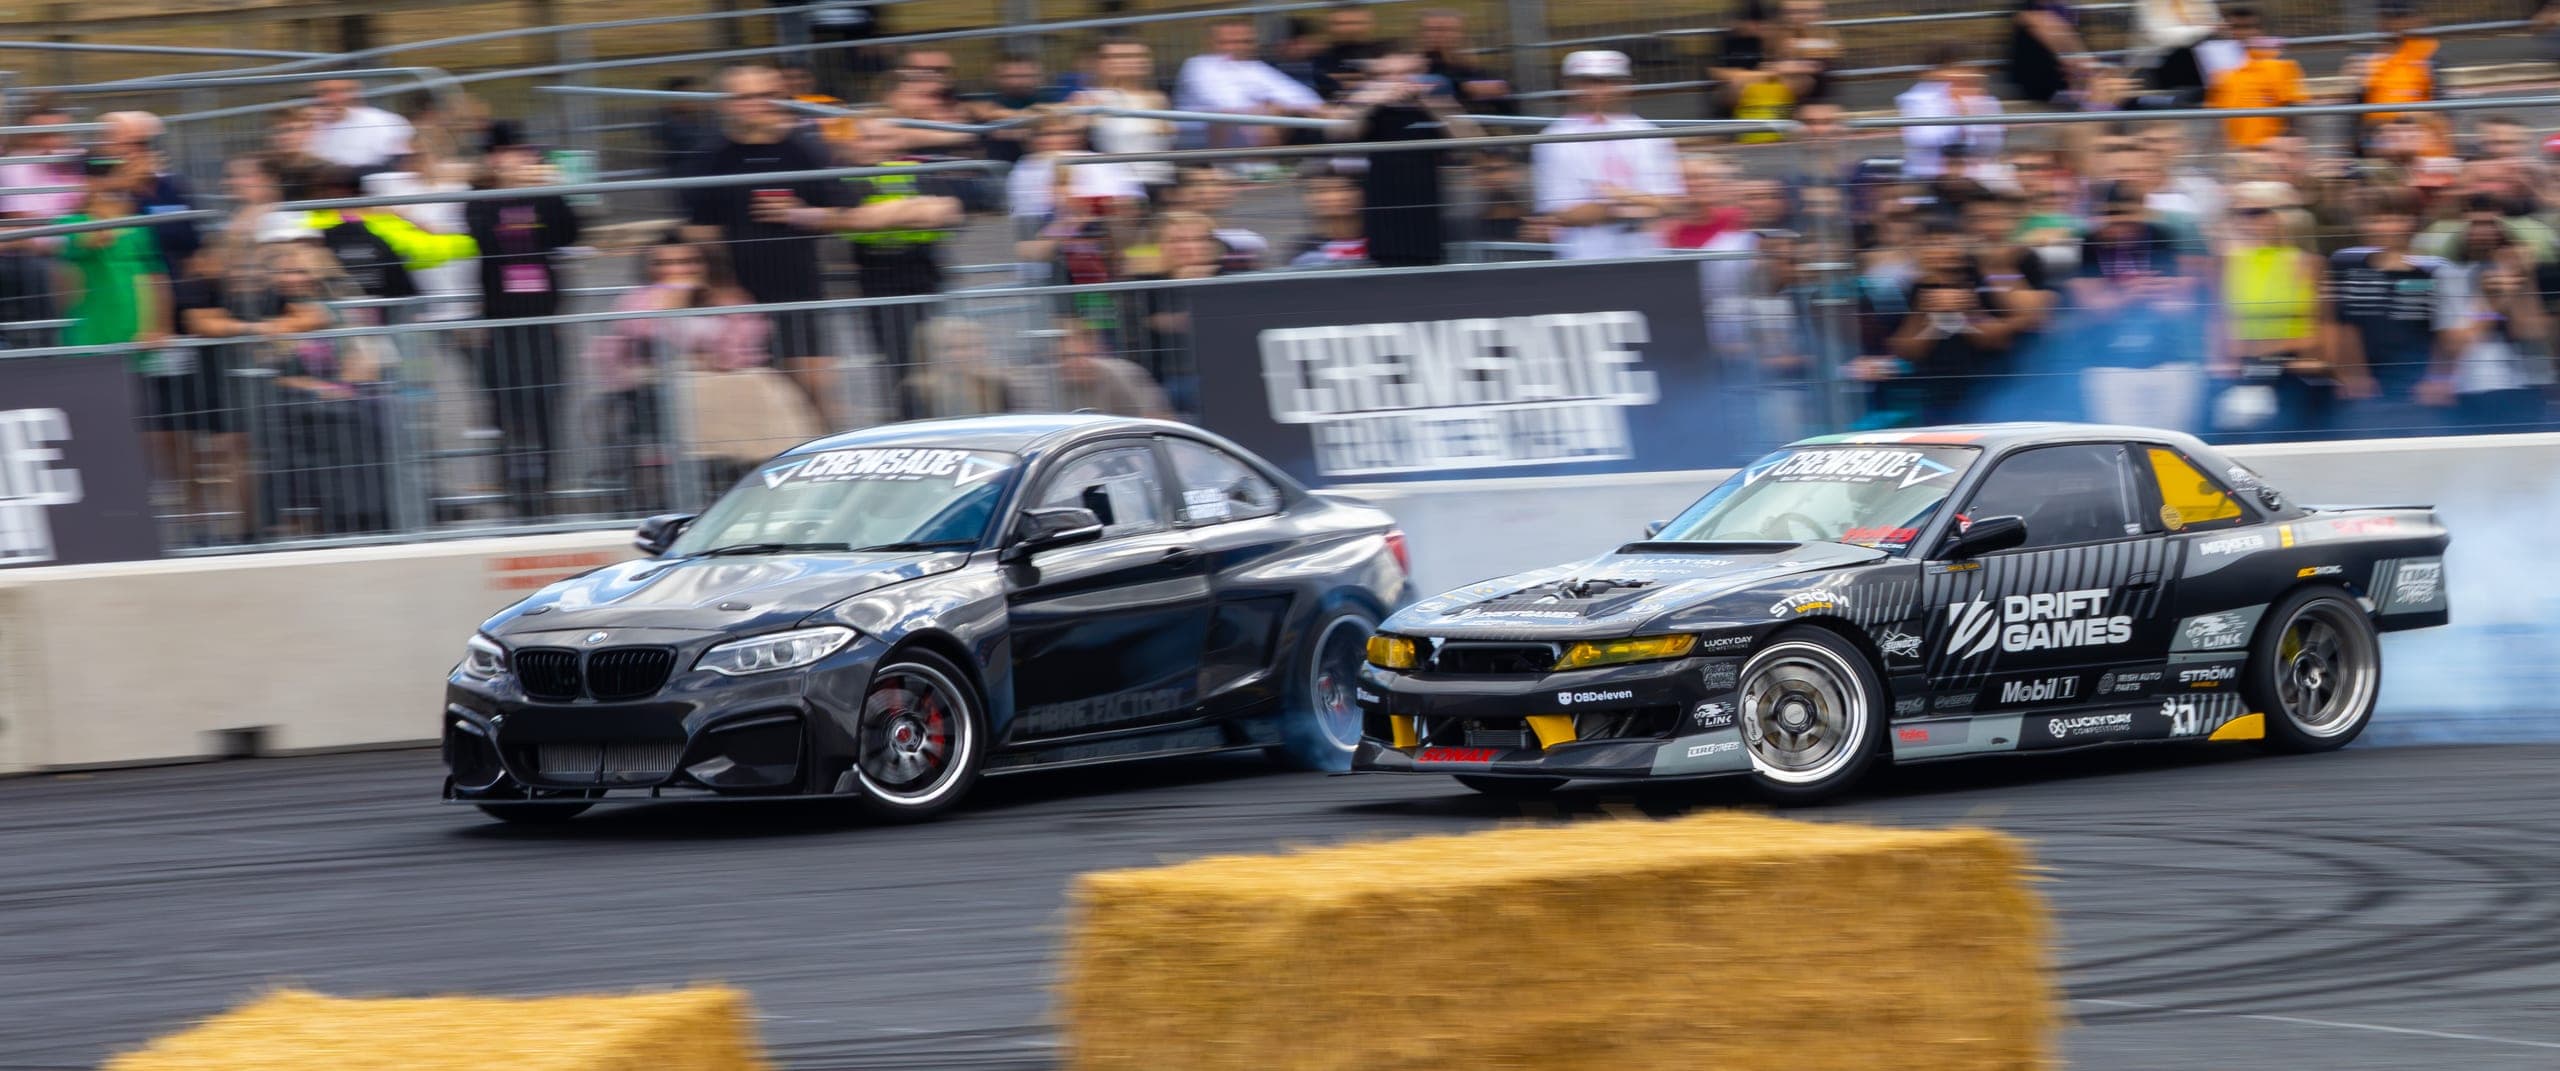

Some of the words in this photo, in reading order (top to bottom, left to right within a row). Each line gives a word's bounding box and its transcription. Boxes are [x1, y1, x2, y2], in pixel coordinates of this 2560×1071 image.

[800, 448, 969, 477] CREWSADE
[1771, 449, 1923, 477] CREWSADE
[1769, 588, 1851, 618] STRÖM
[2003, 588, 2110, 623] DRIFT
[2002, 615, 2132, 652] GAMES
[1704, 639, 1733, 648] LUCKY
[1734, 636, 1752, 644] DAY
[2139, 672, 2162, 680] AUTO
[2179, 666, 2236, 682] STRÖM
[2001, 678, 2058, 703] Mobil
[2114, 682, 2141, 692] PARTS
[1574, 690, 1632, 703] OBDeleven
[2065, 716, 2105, 728] LUCKY
[2105, 713, 2132, 725] DAY
[2073, 724, 2130, 735] COMPETITIONS
[1417, 747, 1498, 763] SONAX
